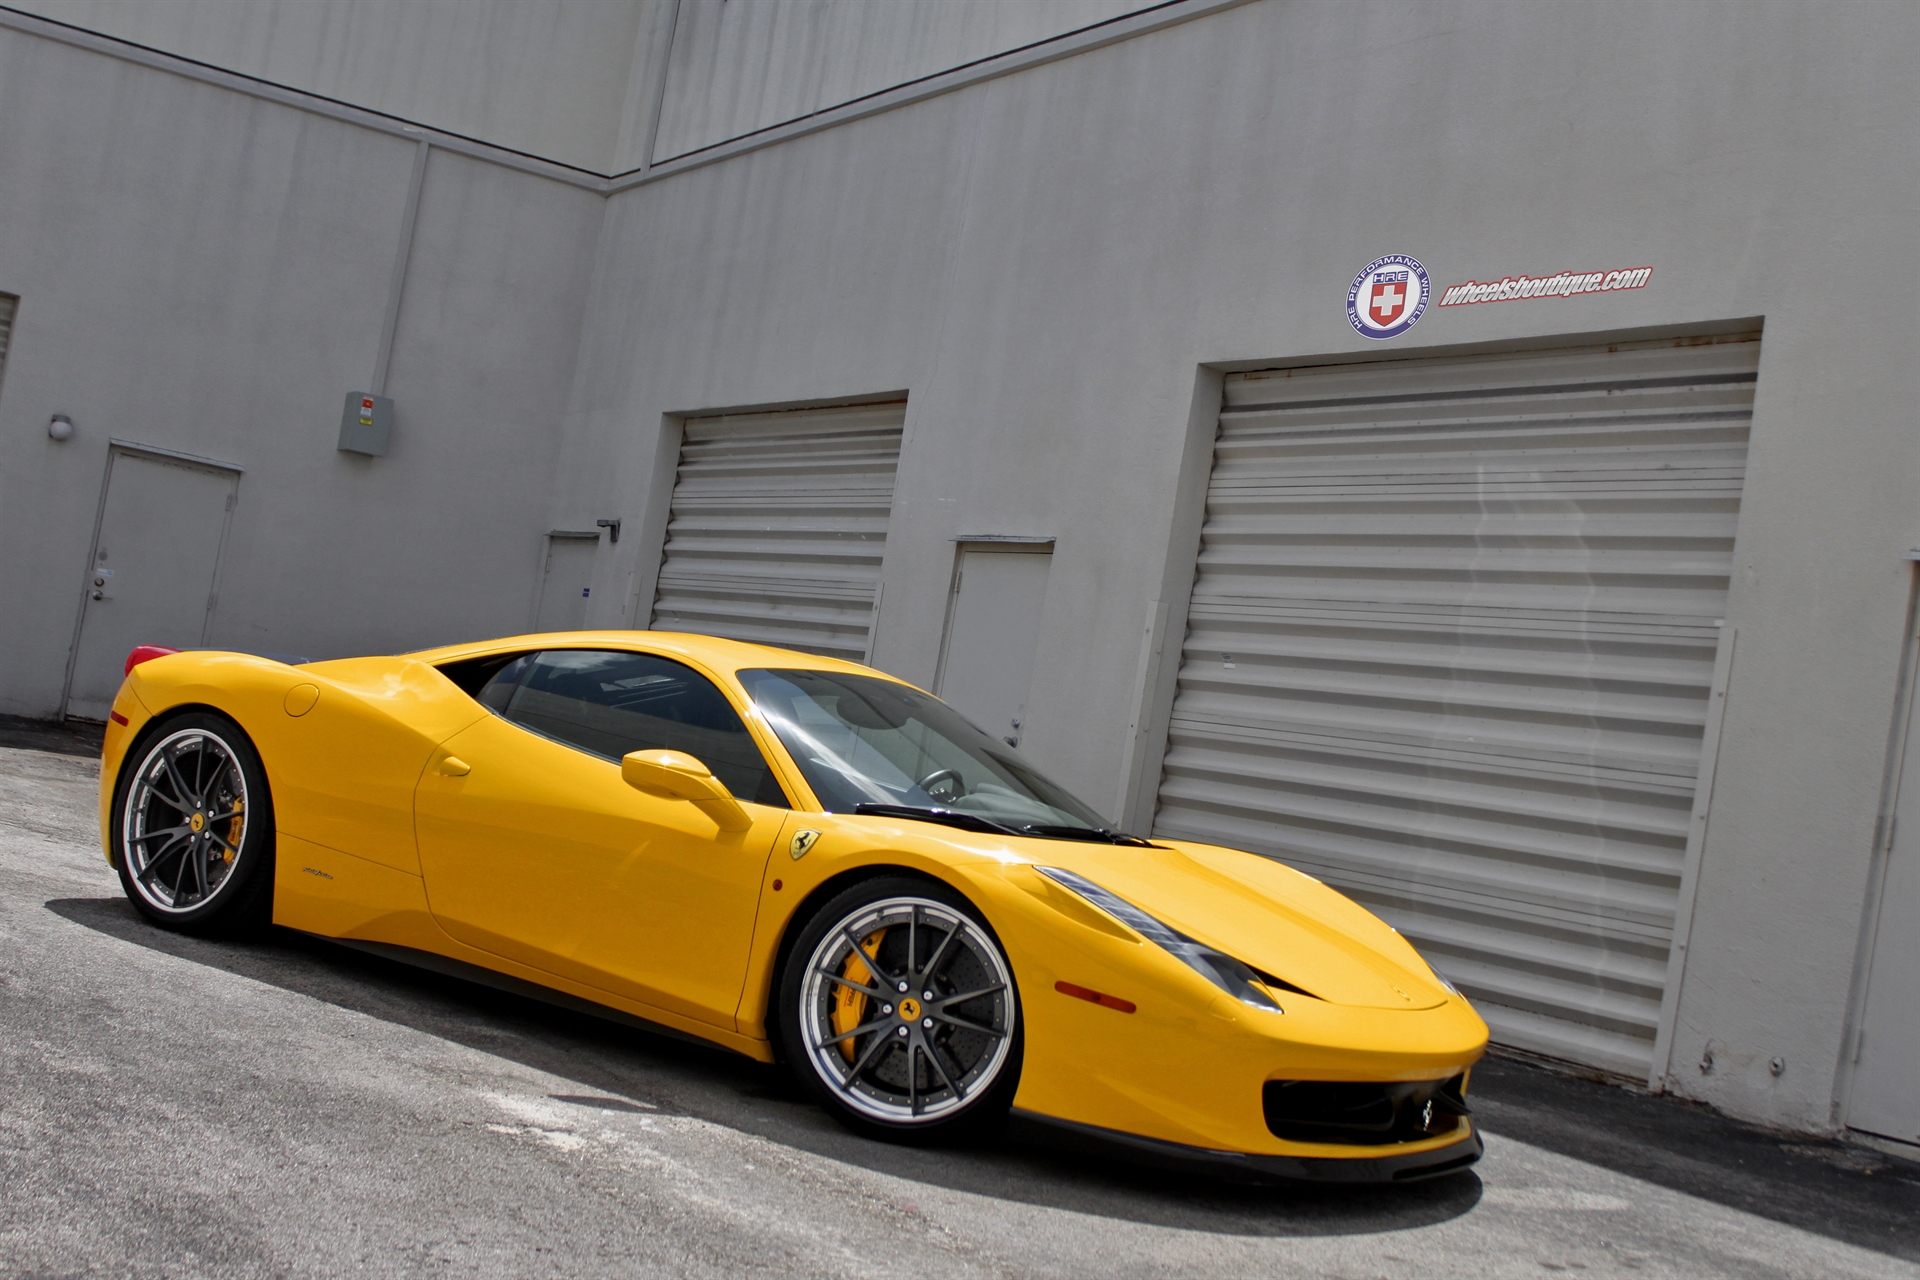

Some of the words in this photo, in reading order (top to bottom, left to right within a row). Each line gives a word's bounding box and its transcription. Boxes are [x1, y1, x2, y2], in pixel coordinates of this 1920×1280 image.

[1348, 256, 1424, 301] PERFORMANCE
[1373, 271, 1409, 283] HRE
[1439, 267, 1652, 306] wheelsboutique.com
[1348, 306, 1363, 329] HRE
[1407, 276, 1429, 325] WHEELS
